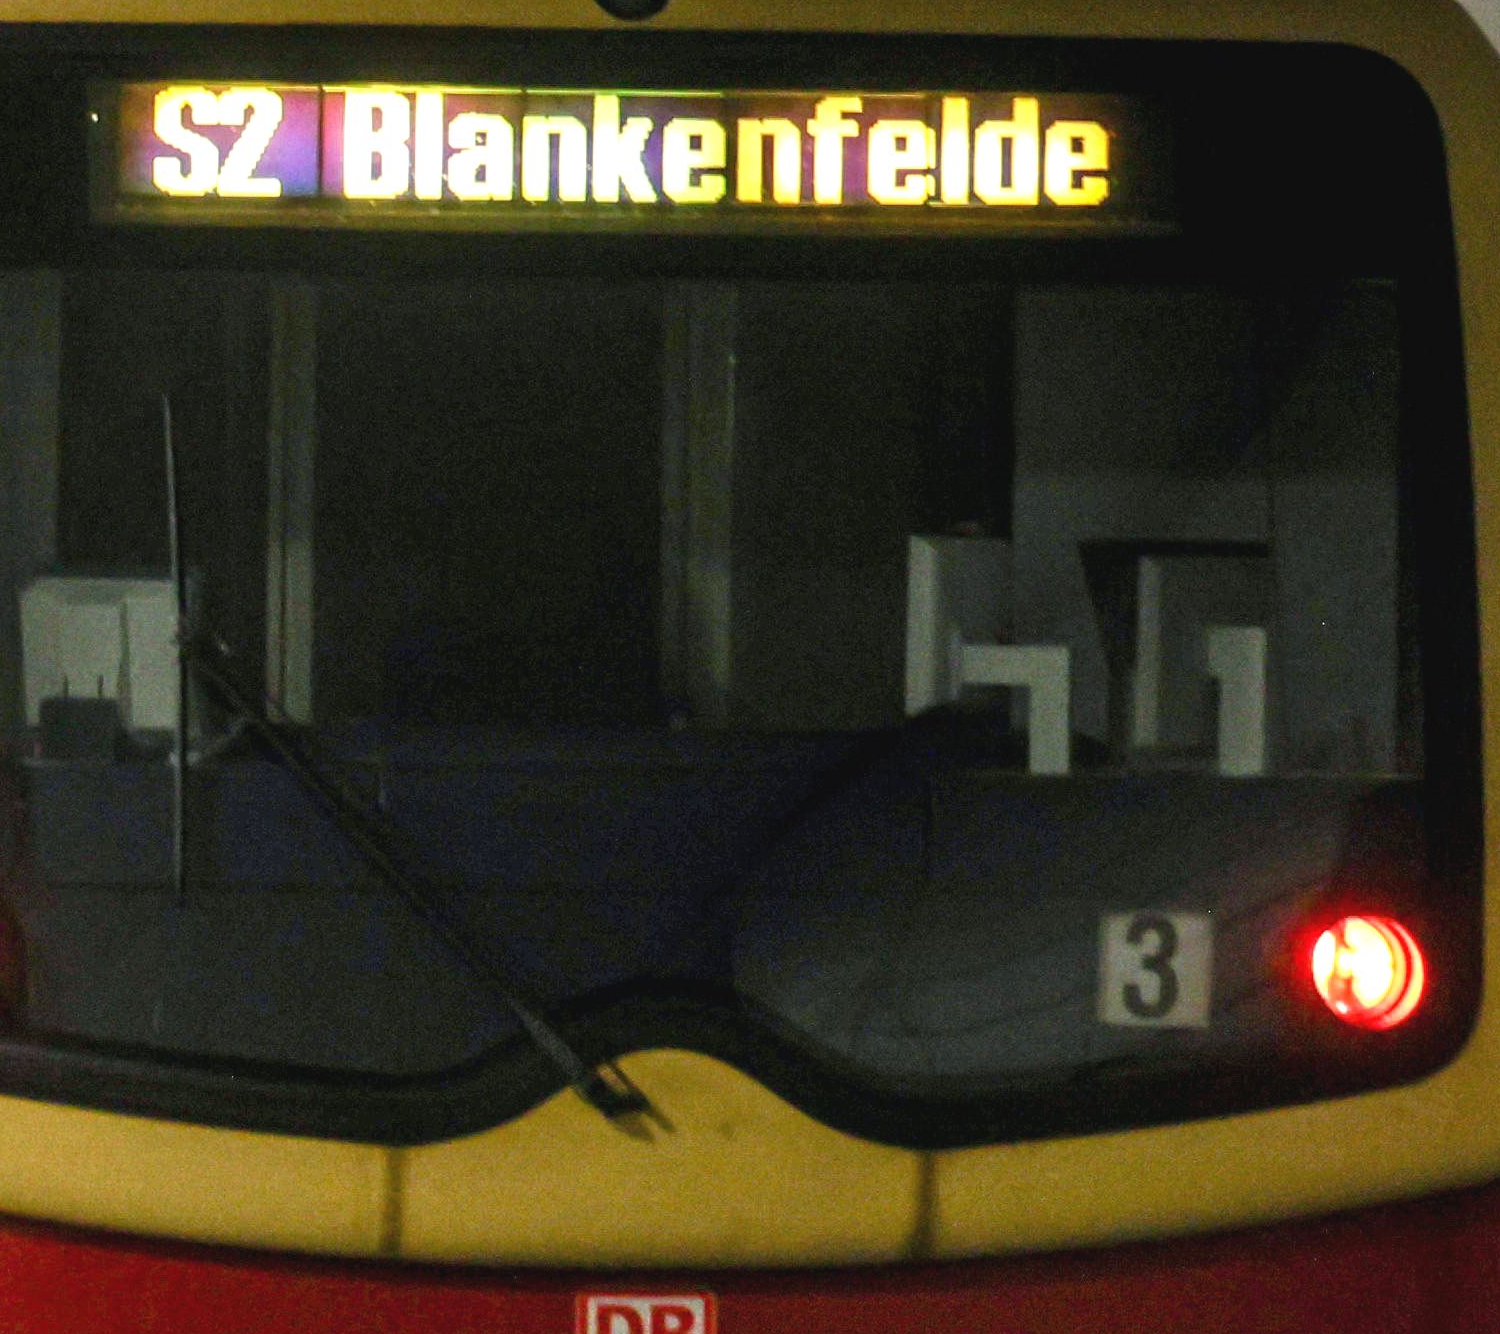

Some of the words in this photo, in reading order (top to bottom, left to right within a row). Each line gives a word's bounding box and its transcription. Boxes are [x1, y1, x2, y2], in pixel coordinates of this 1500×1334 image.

[150, 85, 284, 199] S2
[343, 87, 1113, 207] Blankenfelde
[1121, 913, 1180, 1019] 3
